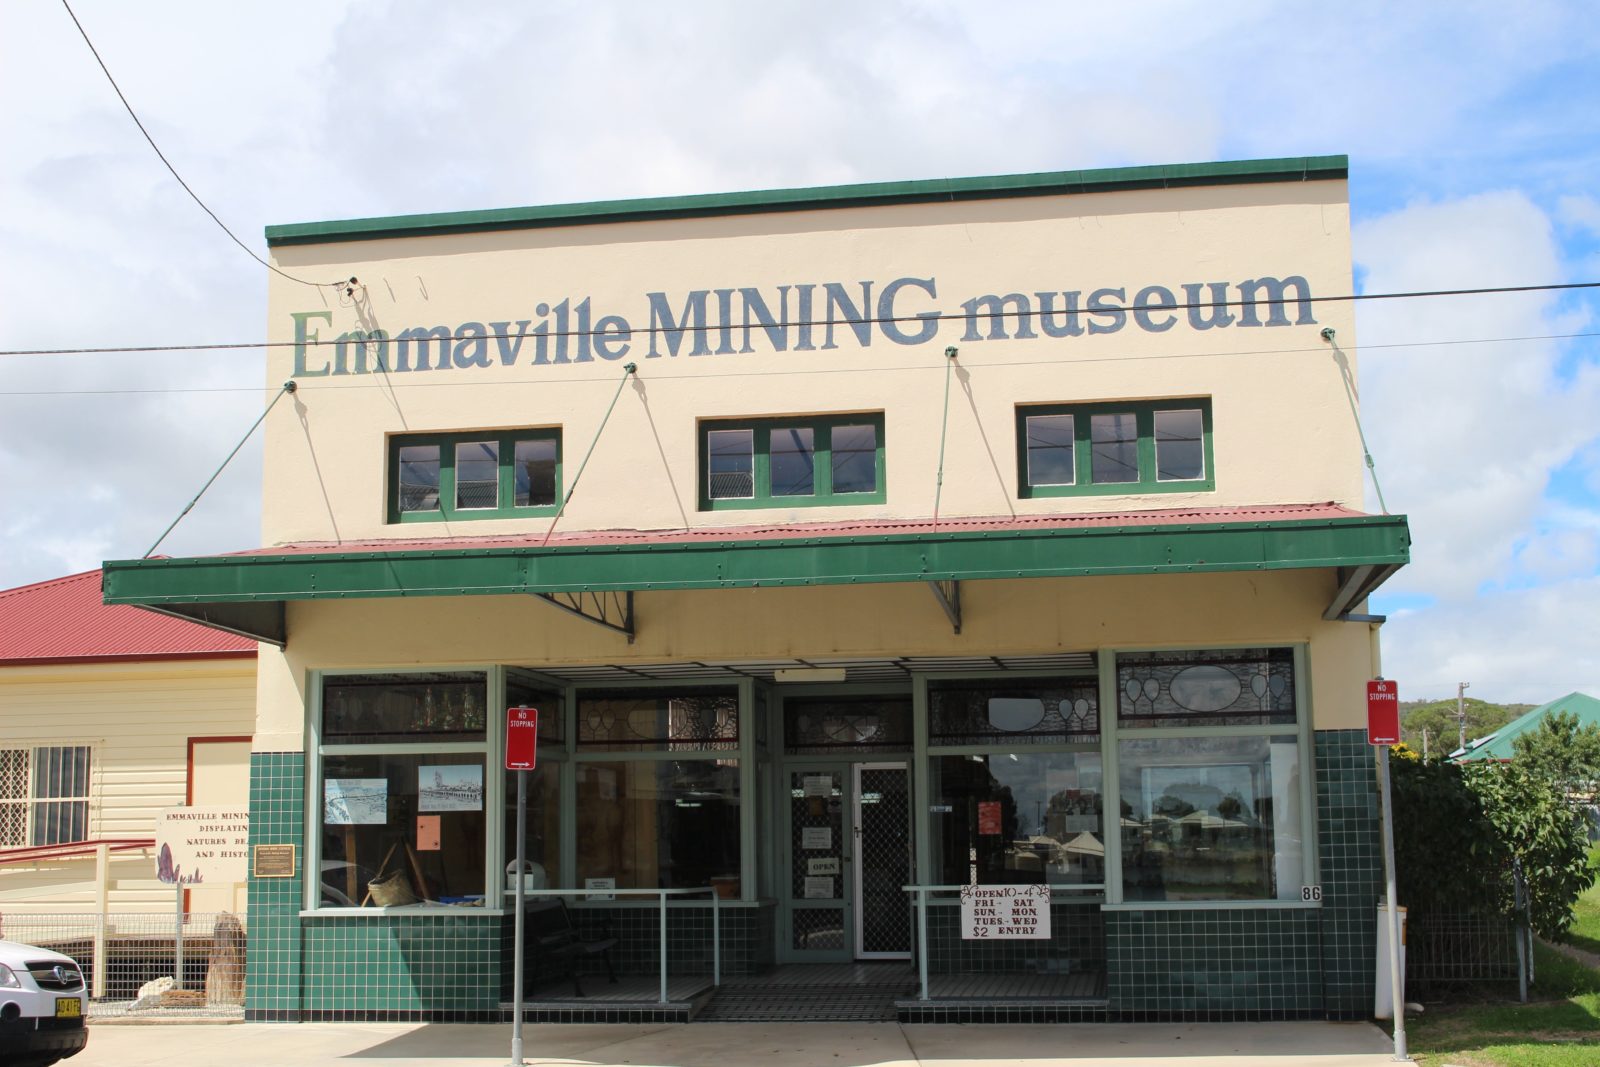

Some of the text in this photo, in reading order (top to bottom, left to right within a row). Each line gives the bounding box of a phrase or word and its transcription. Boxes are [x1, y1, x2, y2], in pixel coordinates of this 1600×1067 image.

[290, 273, 1318, 378] Emmaville MINING museum
[166, 813, 218, 821] EMMAVILLE
[186, 838, 227, 846] NATURES
[813, 862, 836, 871] OPEN
[975, 890, 1004, 898] OPEN
[1302, 886, 1320, 900] 86
[1013, 899, 1034, 907] SAT
[1012, 917, 1038, 925] WED
[973, 926, 988, 937] $2
